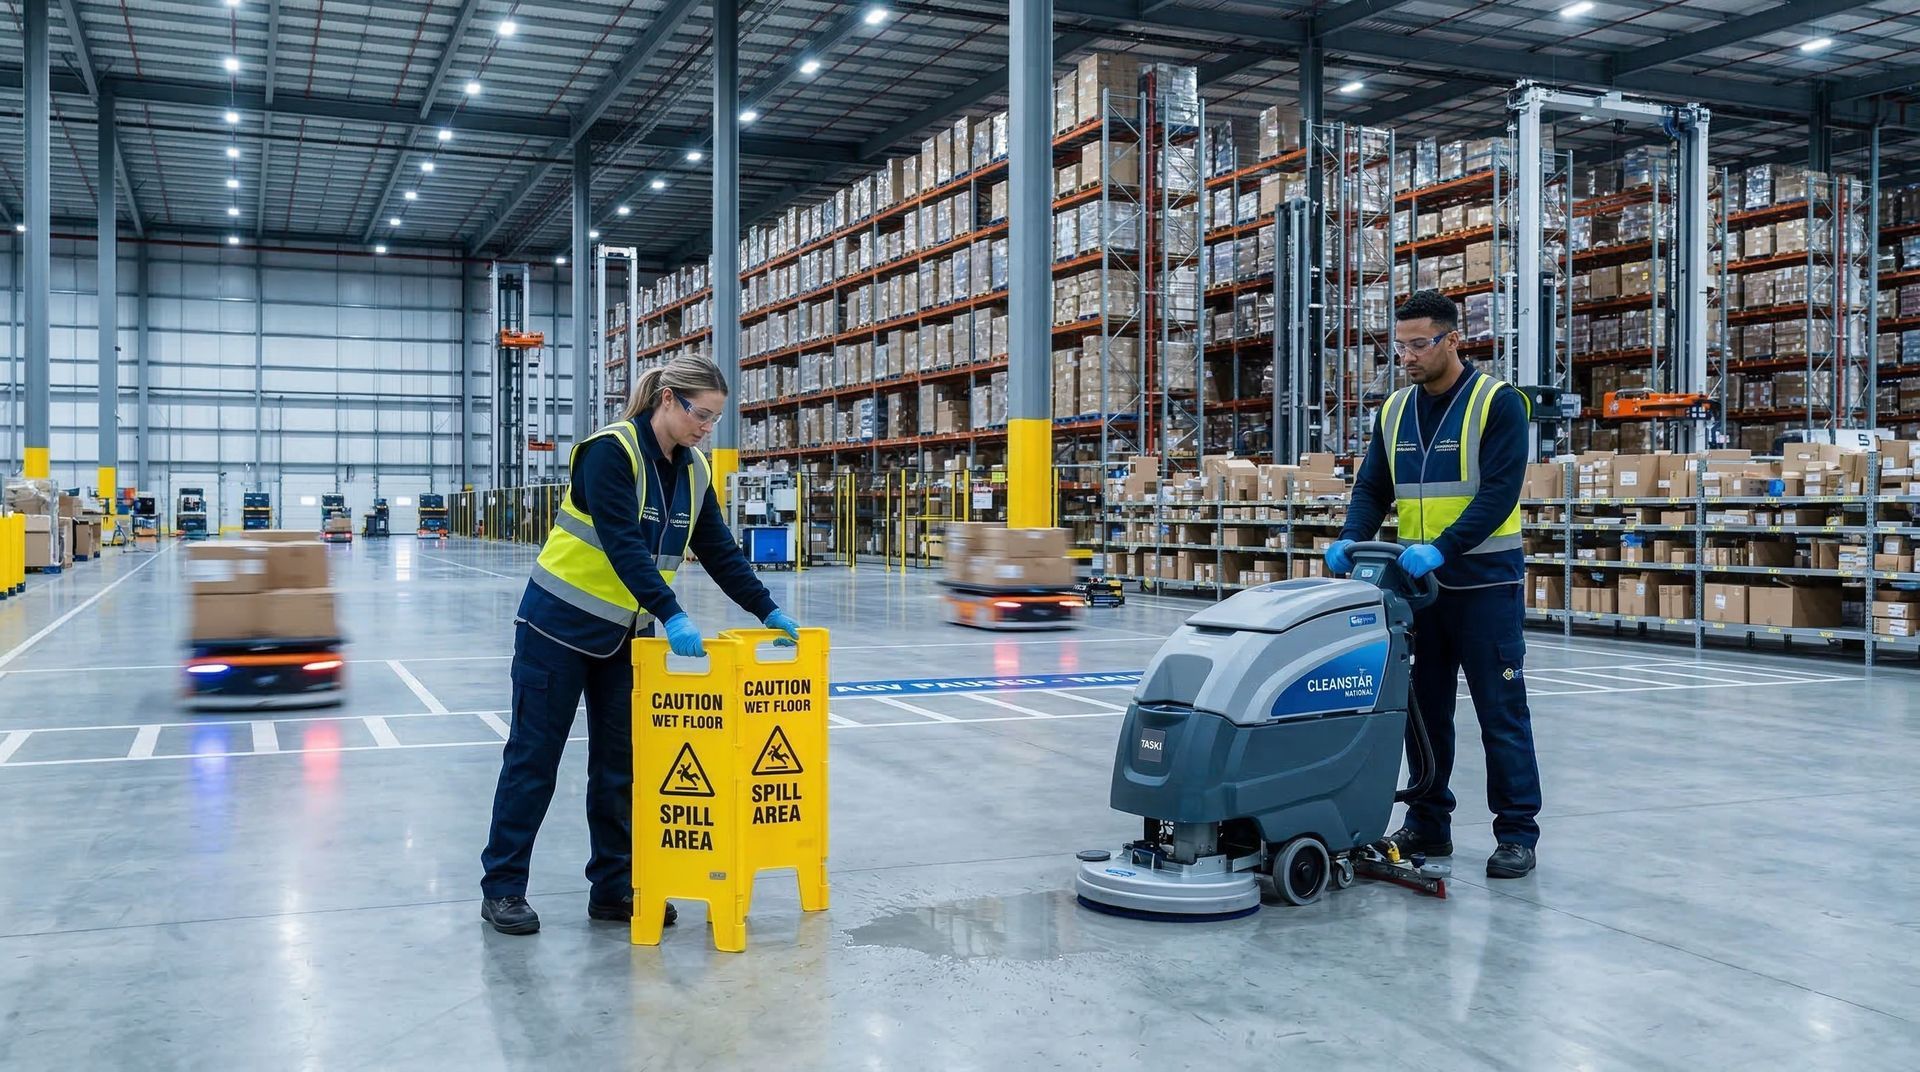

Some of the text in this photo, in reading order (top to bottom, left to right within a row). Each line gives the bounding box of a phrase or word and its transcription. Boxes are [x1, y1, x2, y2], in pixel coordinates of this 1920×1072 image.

[744, 679, 811, 697] CAUTION
[834, 683, 903, 693] AGV
[909, 679, 1046, 689] PAUSED
[1307, 675, 1373, 692] CLEANSTAR
[1344, 689, 1374, 697] NATIONAL
[652, 693, 723, 711] CAUTION
[745, 699, 811, 714] WET FLOOR
[652, 714, 723, 730] WET FLOOR
[1140, 739, 1162, 751] TASKI
[751, 783, 803, 803] SPILL
[659, 804, 714, 827] SPILL
[752, 804, 801, 825] AREA
[661, 829, 713, 851] AREA
